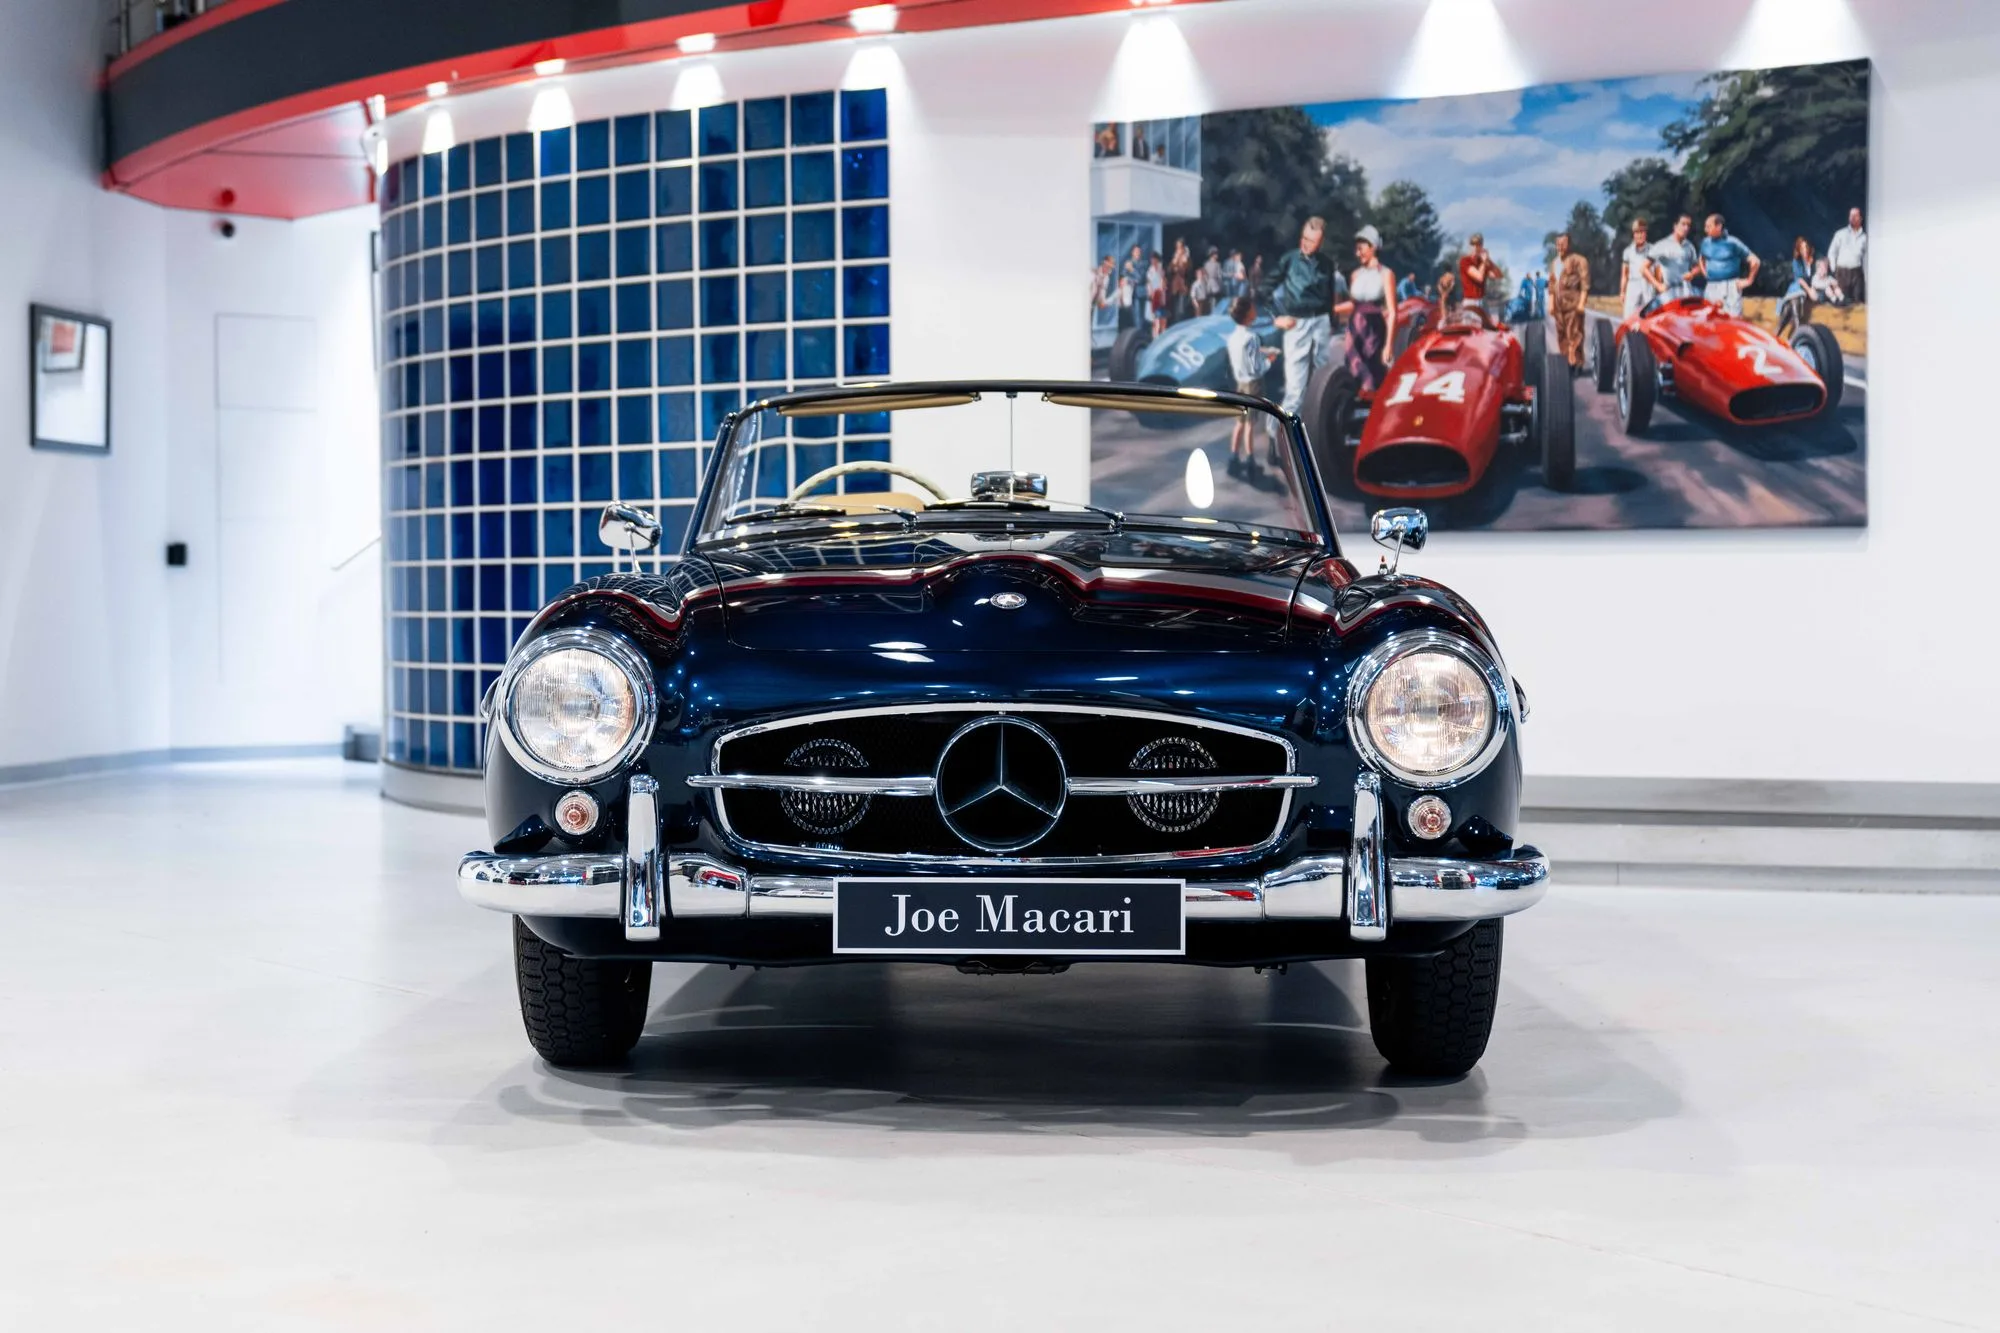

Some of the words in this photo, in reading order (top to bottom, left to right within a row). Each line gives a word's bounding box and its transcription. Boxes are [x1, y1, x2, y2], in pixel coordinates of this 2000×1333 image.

[1170, 341, 1204, 370] 18
[1738, 344, 1783, 375] 2
[1384, 370, 1465, 407] 14
[884, 894, 960, 937] Joe
[975, 894, 1135, 934] Macari
